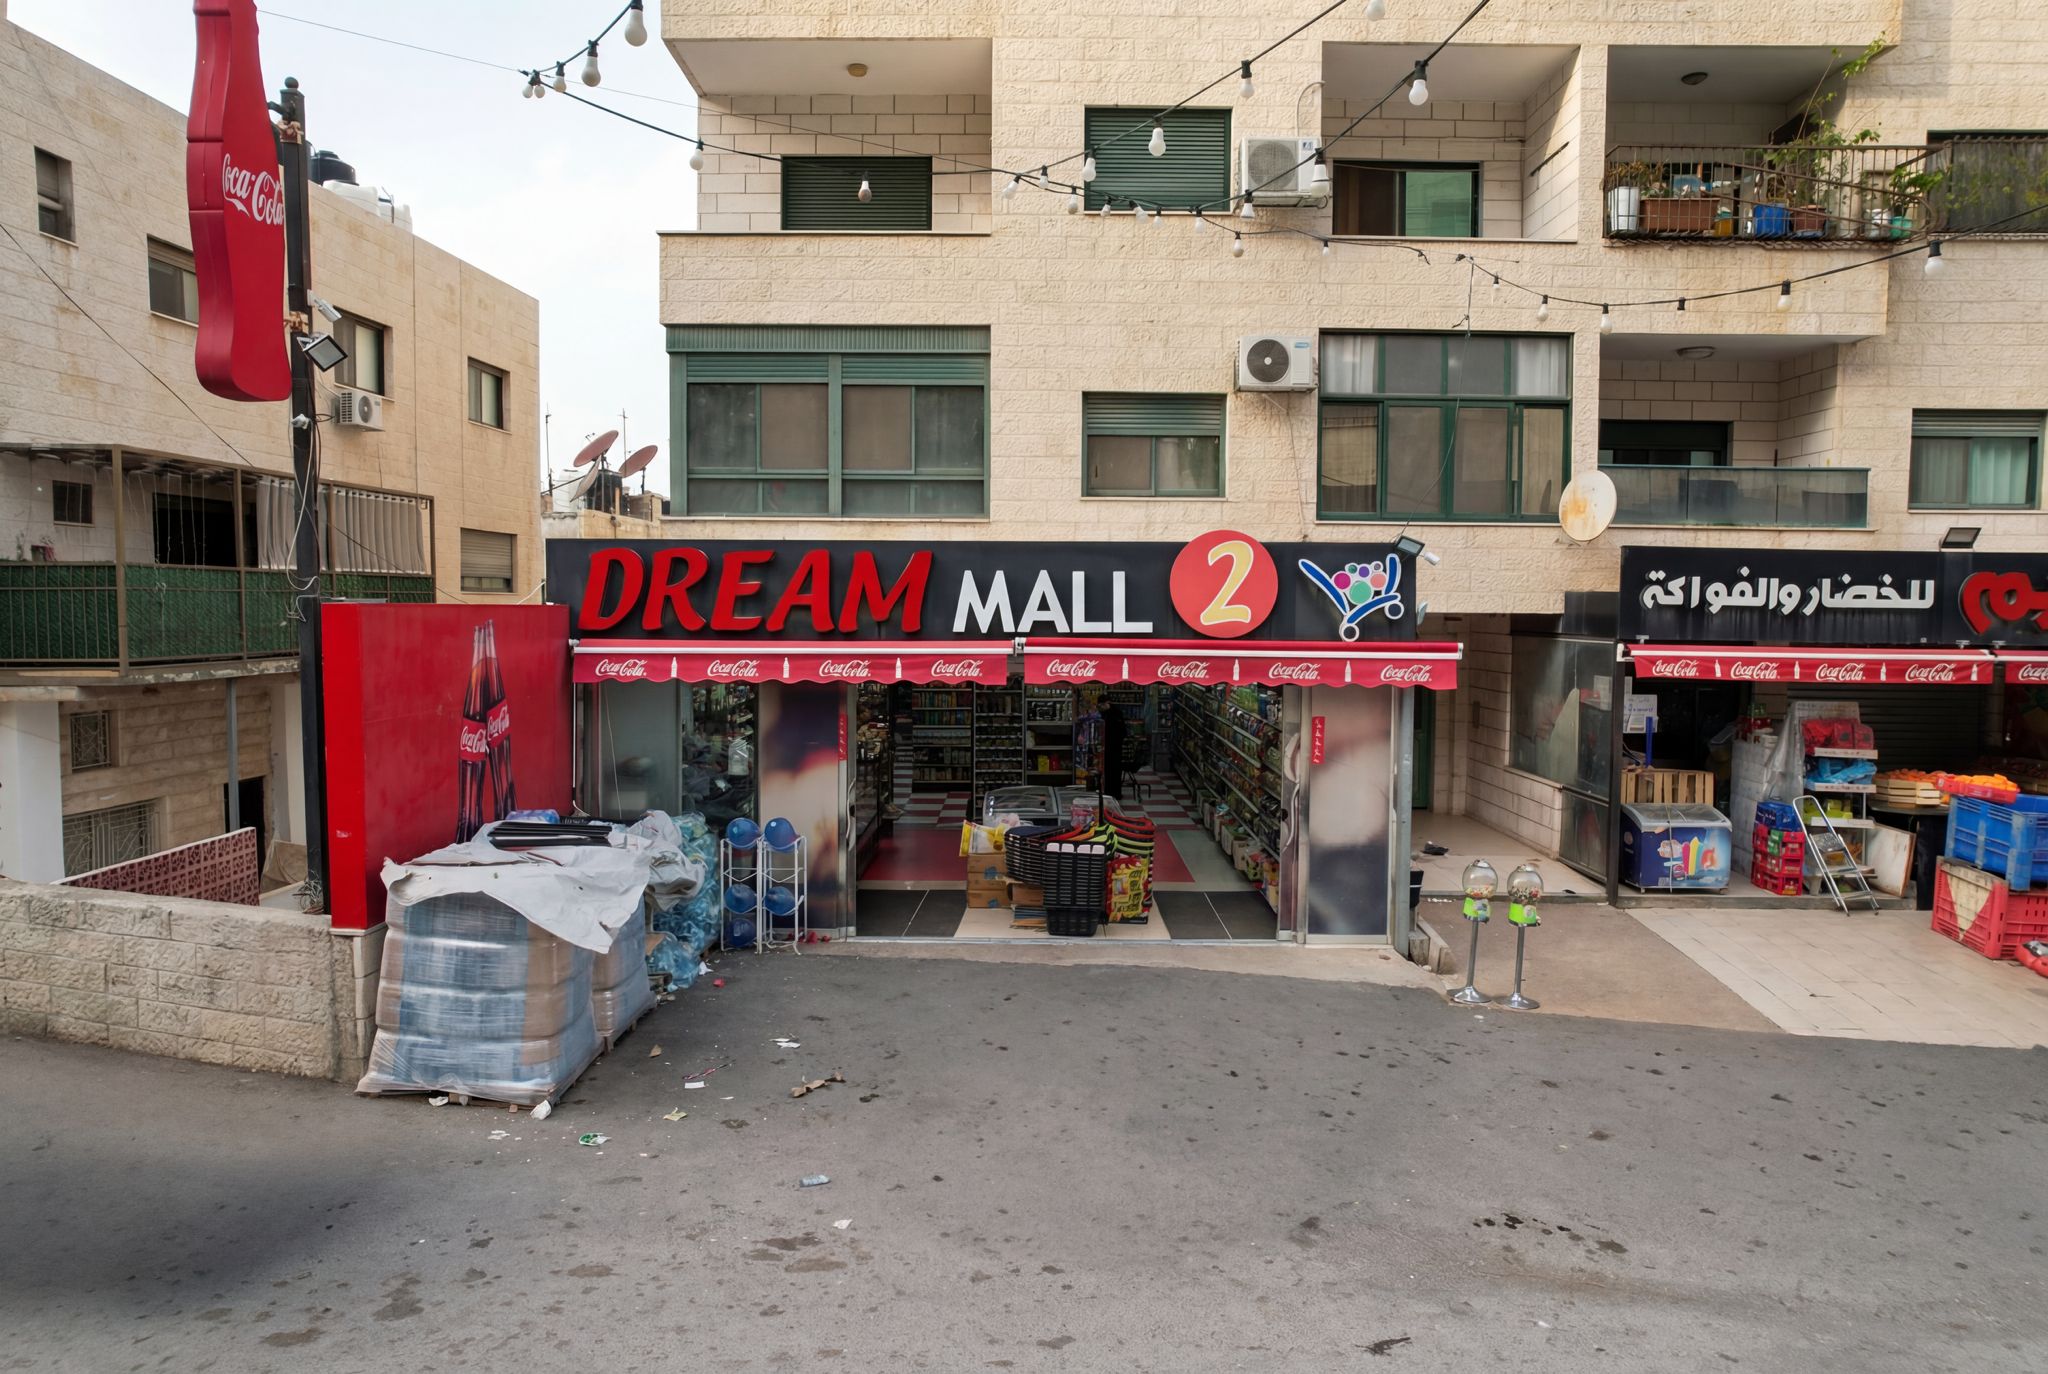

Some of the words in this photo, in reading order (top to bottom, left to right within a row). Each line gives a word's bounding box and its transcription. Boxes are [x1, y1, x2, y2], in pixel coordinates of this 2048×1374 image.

[222, 153, 284, 226] Coca-Cola
[578, 547, 933, 634] DREAM
[953, 569, 1153, 634] MALL
[1199, 540, 1254, 626] 2
[1801, 573, 1935, 617] للخضار
